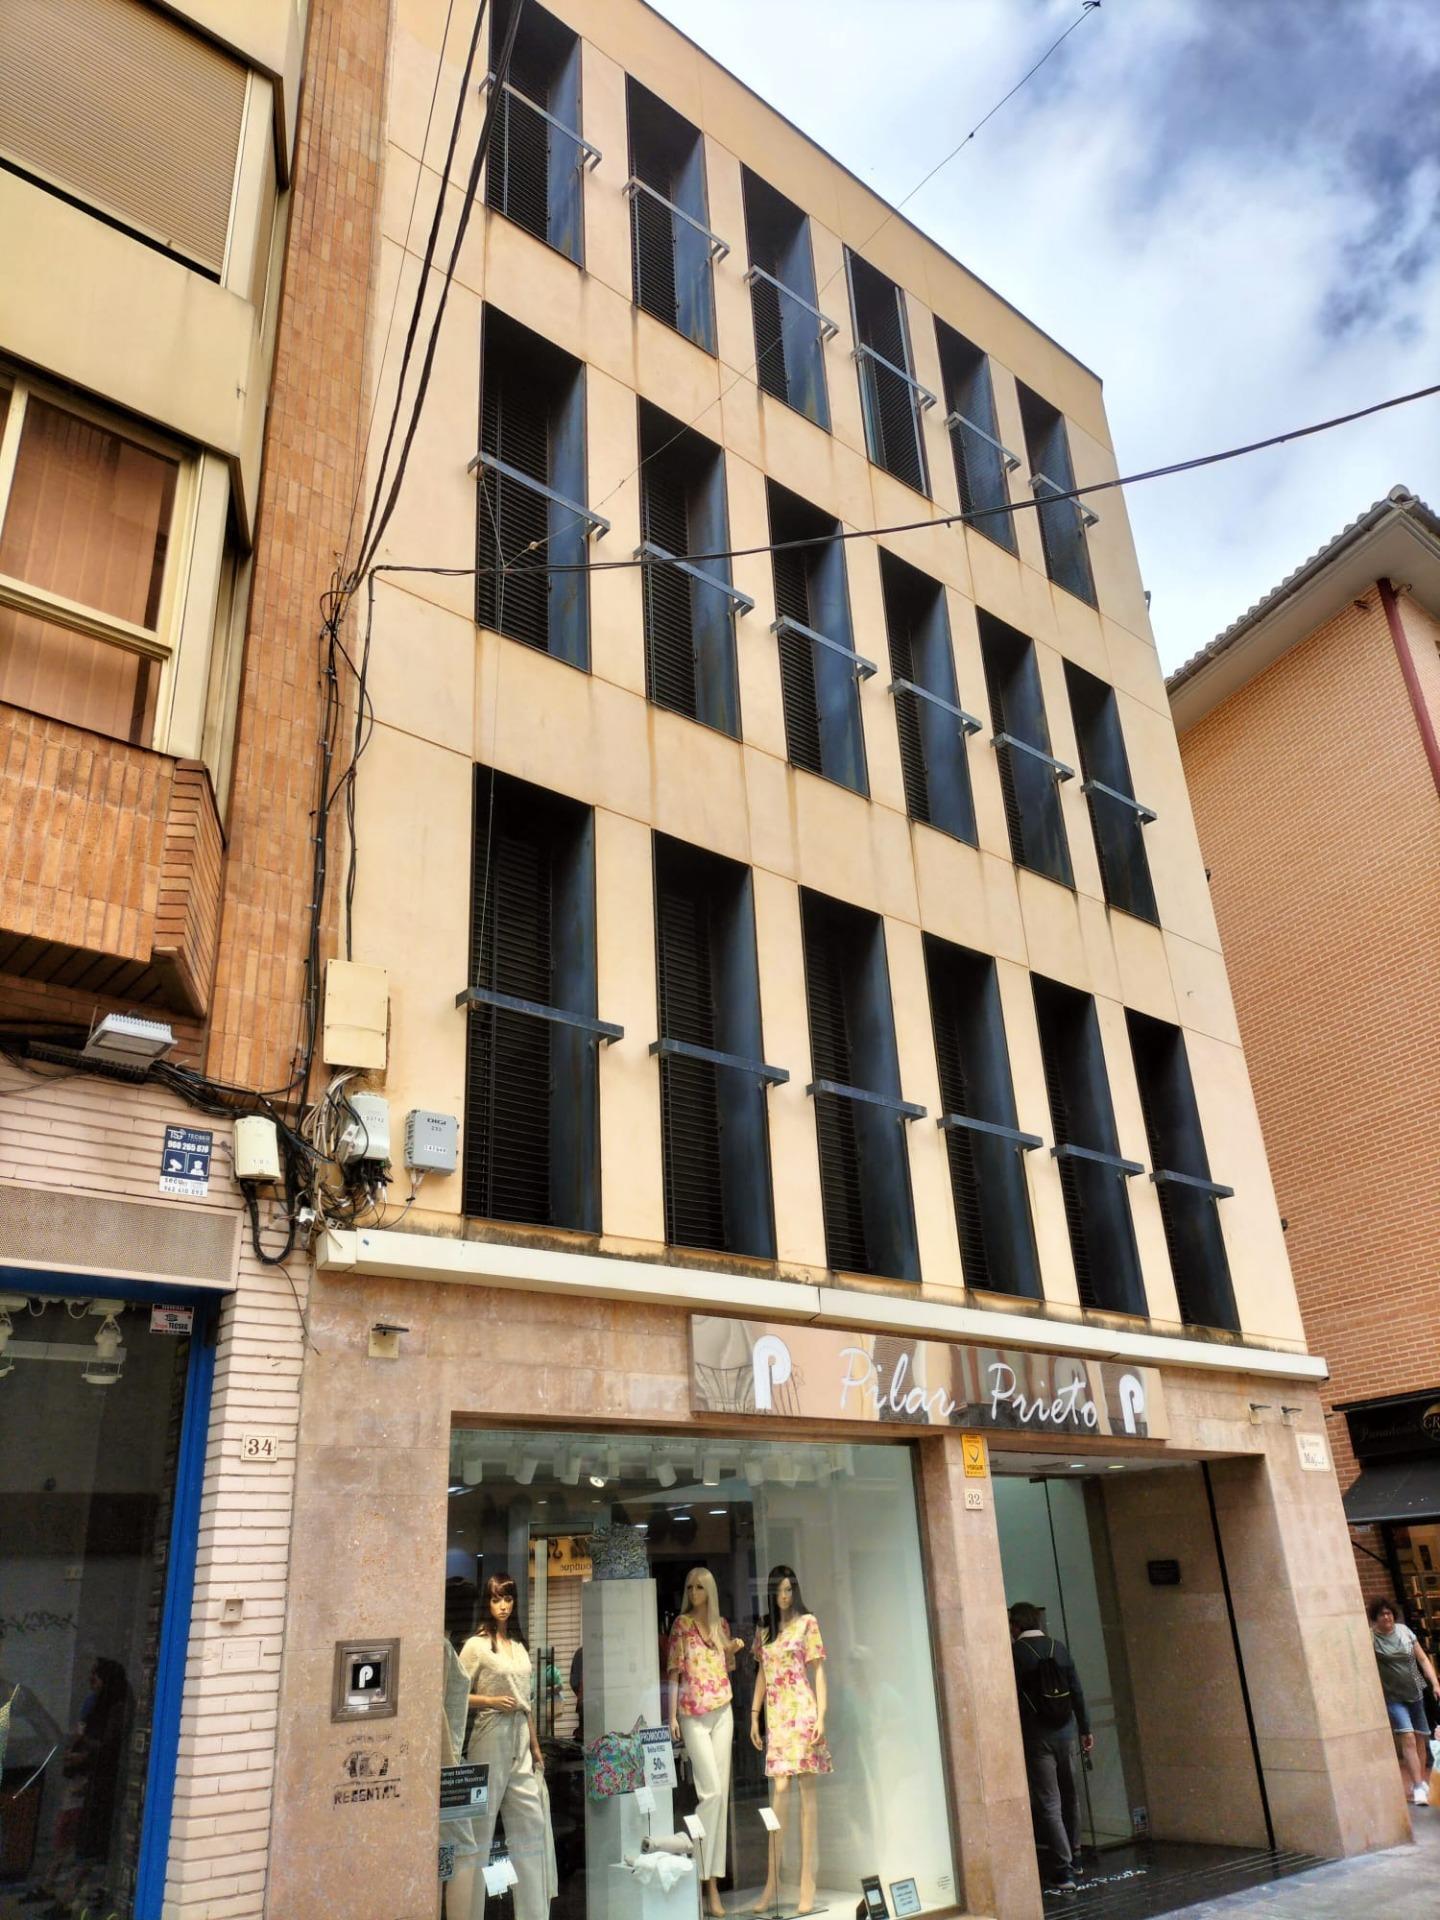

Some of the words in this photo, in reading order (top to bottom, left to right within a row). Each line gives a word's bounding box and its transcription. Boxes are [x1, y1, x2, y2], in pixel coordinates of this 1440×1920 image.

[838, 1346, 957, 1418] Pilar
[987, 1362, 1097, 1428] Prieto
[247, 1438, 273, 1456] 34
[967, 1493, 981, 1506] 32
